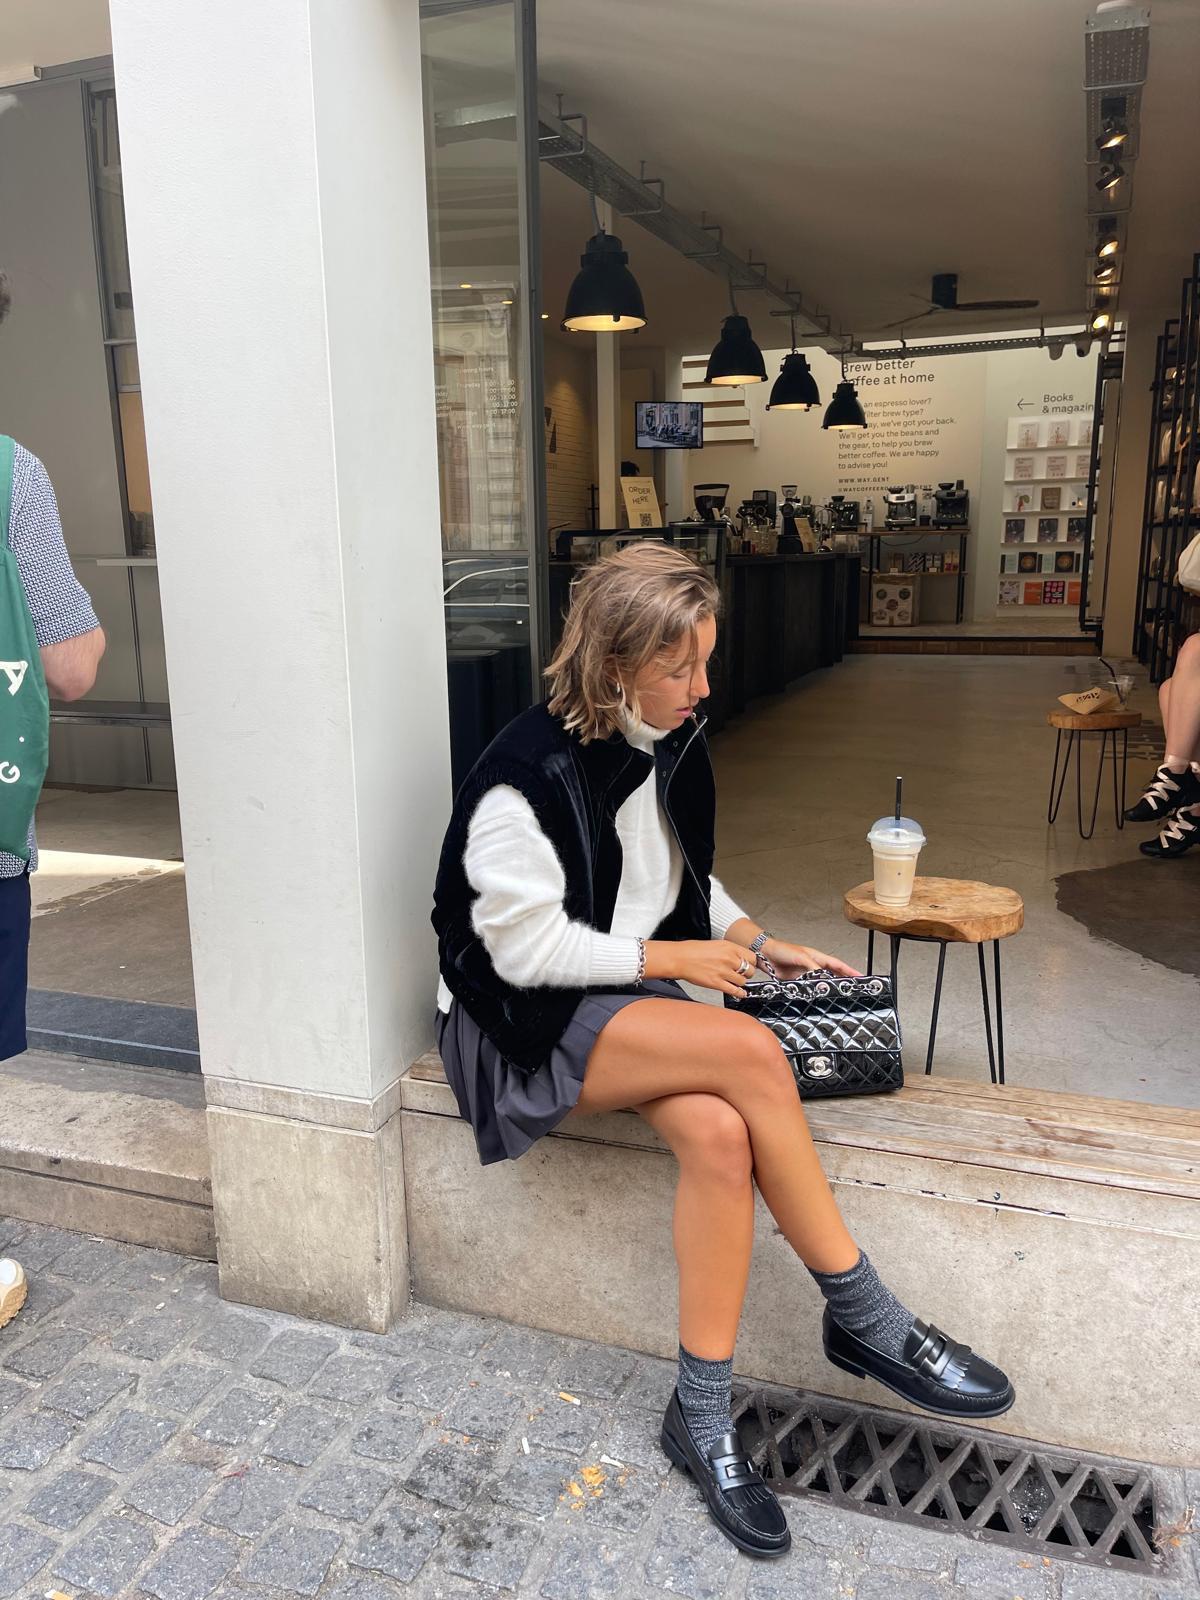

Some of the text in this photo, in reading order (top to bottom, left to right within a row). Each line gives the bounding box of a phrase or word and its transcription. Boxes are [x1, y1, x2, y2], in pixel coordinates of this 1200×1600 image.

[842, 359, 915, 373] Brew better
[883, 374, 897, 385] at
[900, 373, 935, 384] home
[874, 400, 908, 409] espresso
[909, 397, 932, 406] lover?
[1043, 393, 1074, 403] Books
[902, 408, 924, 417] type?
[1042, 403, 1094, 414] & magazin
[880, 419, 901, 428] we've
[902, 419, 916, 429] got
[917, 418, 934, 427] your
[935, 416, 957, 425] back.
[839, 428, 940, 440] We'll get you the beans and
[838, 442, 851, 450] the
[852, 441, 871, 450] gear,
[881, 440, 898, 449] help
[898, 440, 913, 449] you
[914, 438, 933, 446] brew
[838, 451, 862, 460] better
[862, 450, 888, 459] coffee.
[915, 448, 940, 458] happy
[838, 460, 888, 470] to advise you!
[628, 486, 651, 494] ORDER
[632, 496, 648, 504] HERE
